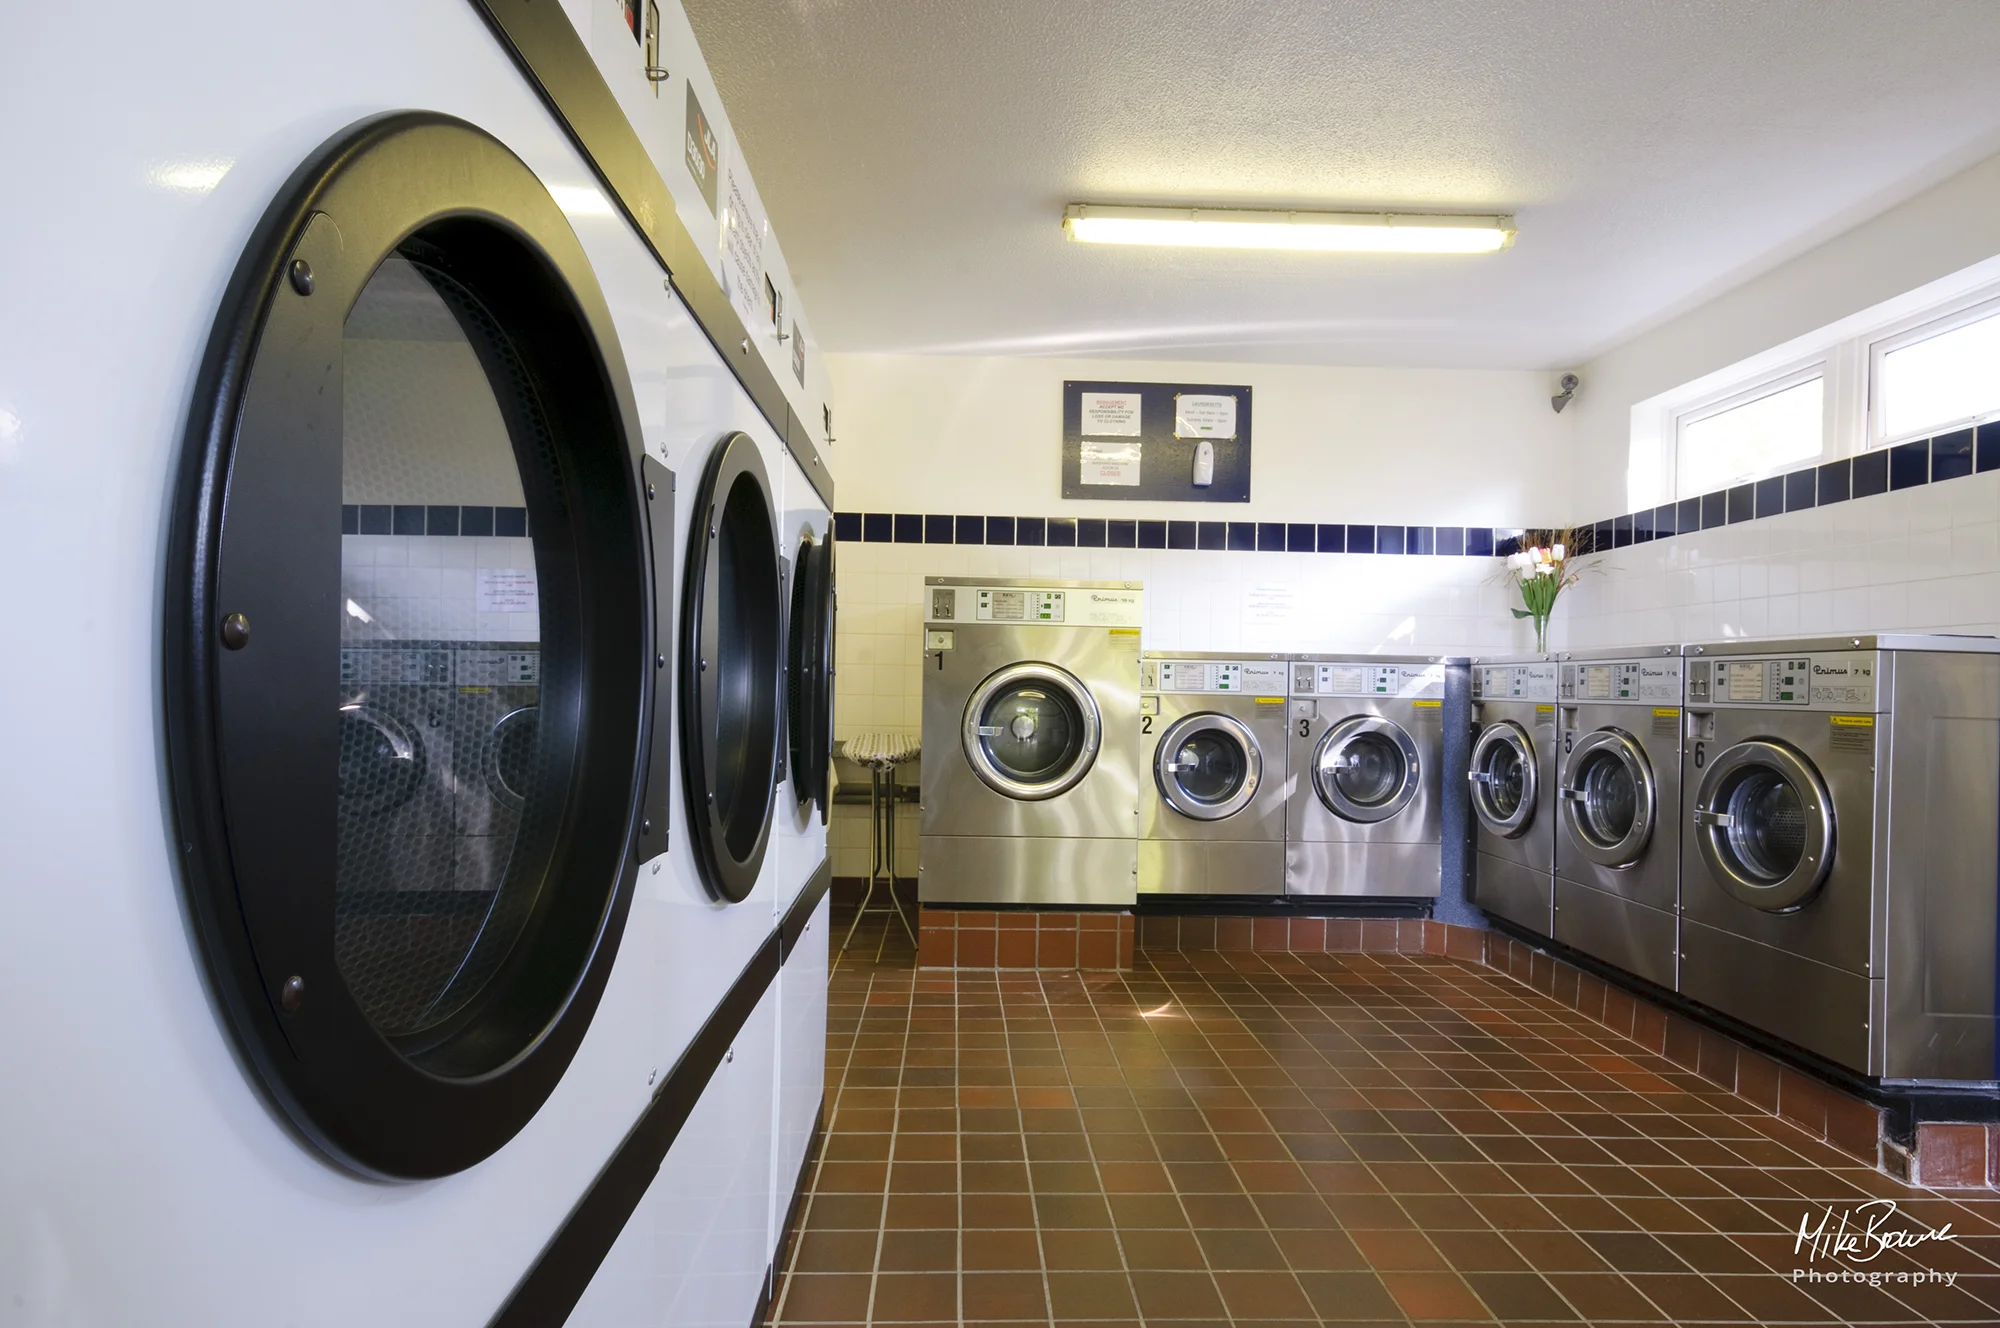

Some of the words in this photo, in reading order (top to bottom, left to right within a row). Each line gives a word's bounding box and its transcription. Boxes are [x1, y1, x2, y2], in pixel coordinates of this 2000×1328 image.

[704, 129, 715, 162] JLA
[935, 651, 942, 670] 1
[1813, 665, 1848, 675] Primus
[1641, 668, 1663, 676] Primus
[1142, 716, 1152, 734] 2
[1300, 719, 1310, 738] 3
[1566, 732, 1572, 754] 5
[1695, 741, 1704, 768] 6
